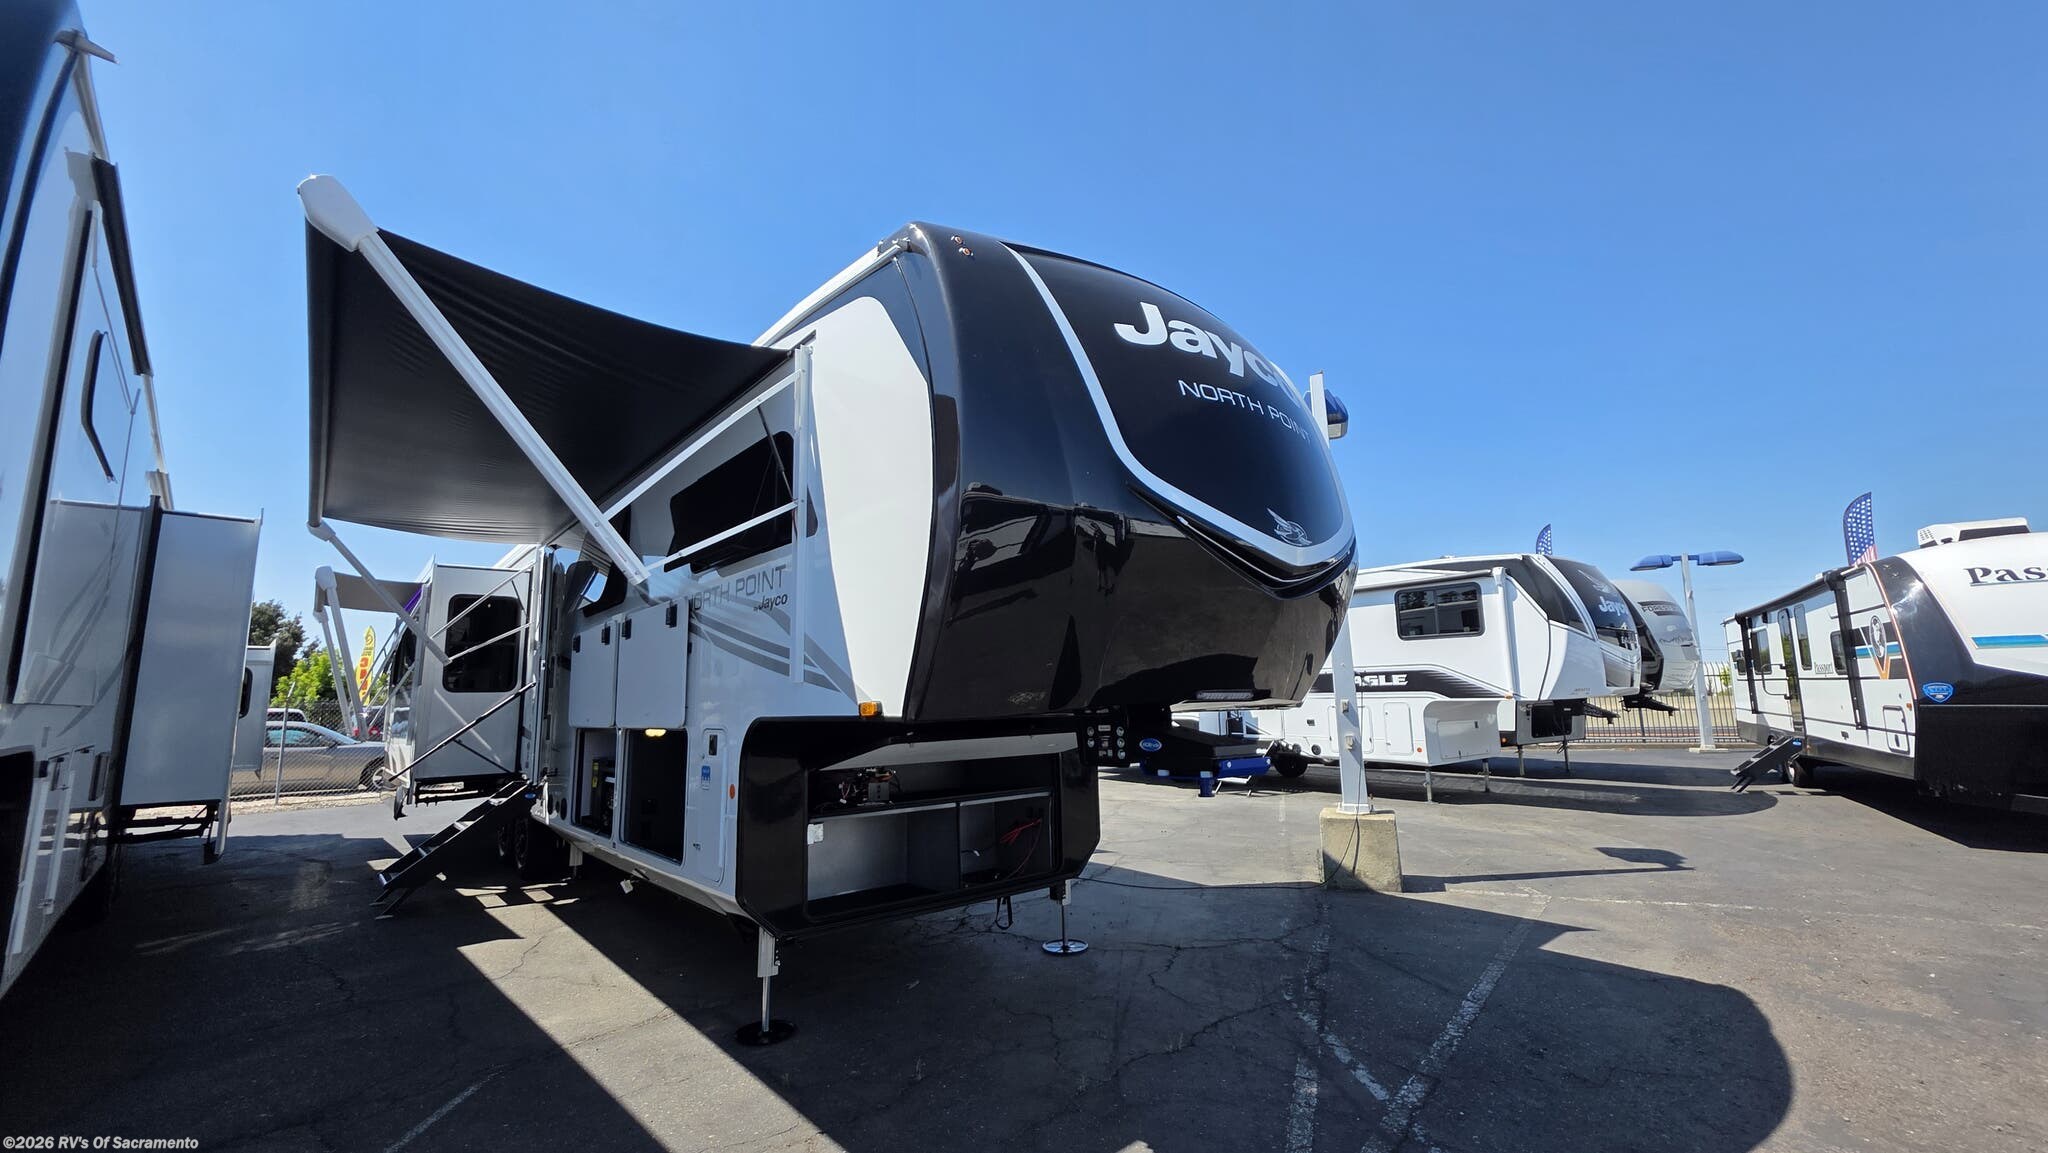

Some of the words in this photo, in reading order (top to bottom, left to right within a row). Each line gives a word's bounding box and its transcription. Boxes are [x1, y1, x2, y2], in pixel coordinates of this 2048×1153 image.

[1178, 380, 1264, 415] NORTH
[1268, 405, 1310, 444] POINT
[735, 565, 786, 597] POINT
[1963, 567, 2048, 584] Pas
[758, 594, 788, 611] Jayco
